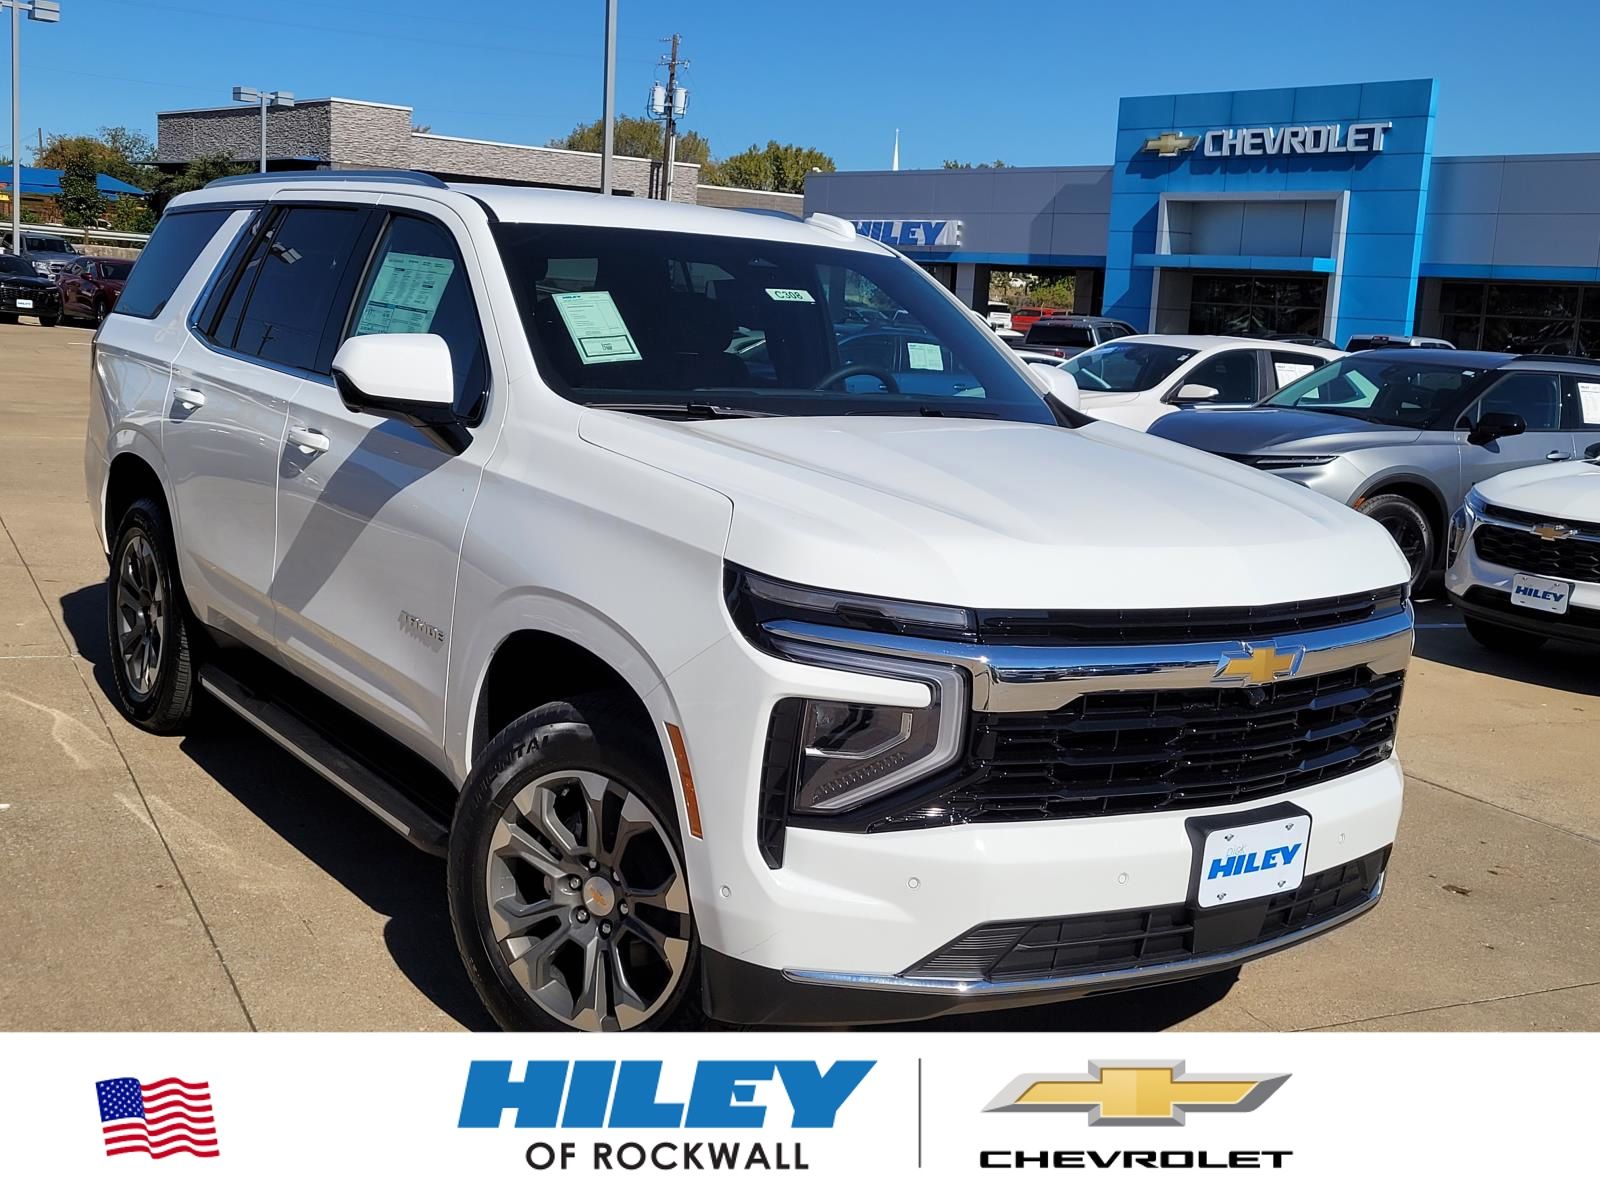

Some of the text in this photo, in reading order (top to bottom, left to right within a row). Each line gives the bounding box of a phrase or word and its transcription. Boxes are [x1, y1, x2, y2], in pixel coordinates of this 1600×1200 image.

[1204, 121, 1392, 157] CHEVROLET
[1515, 585, 1566, 602] HILEY
[1207, 842, 1303, 881] HILEY
